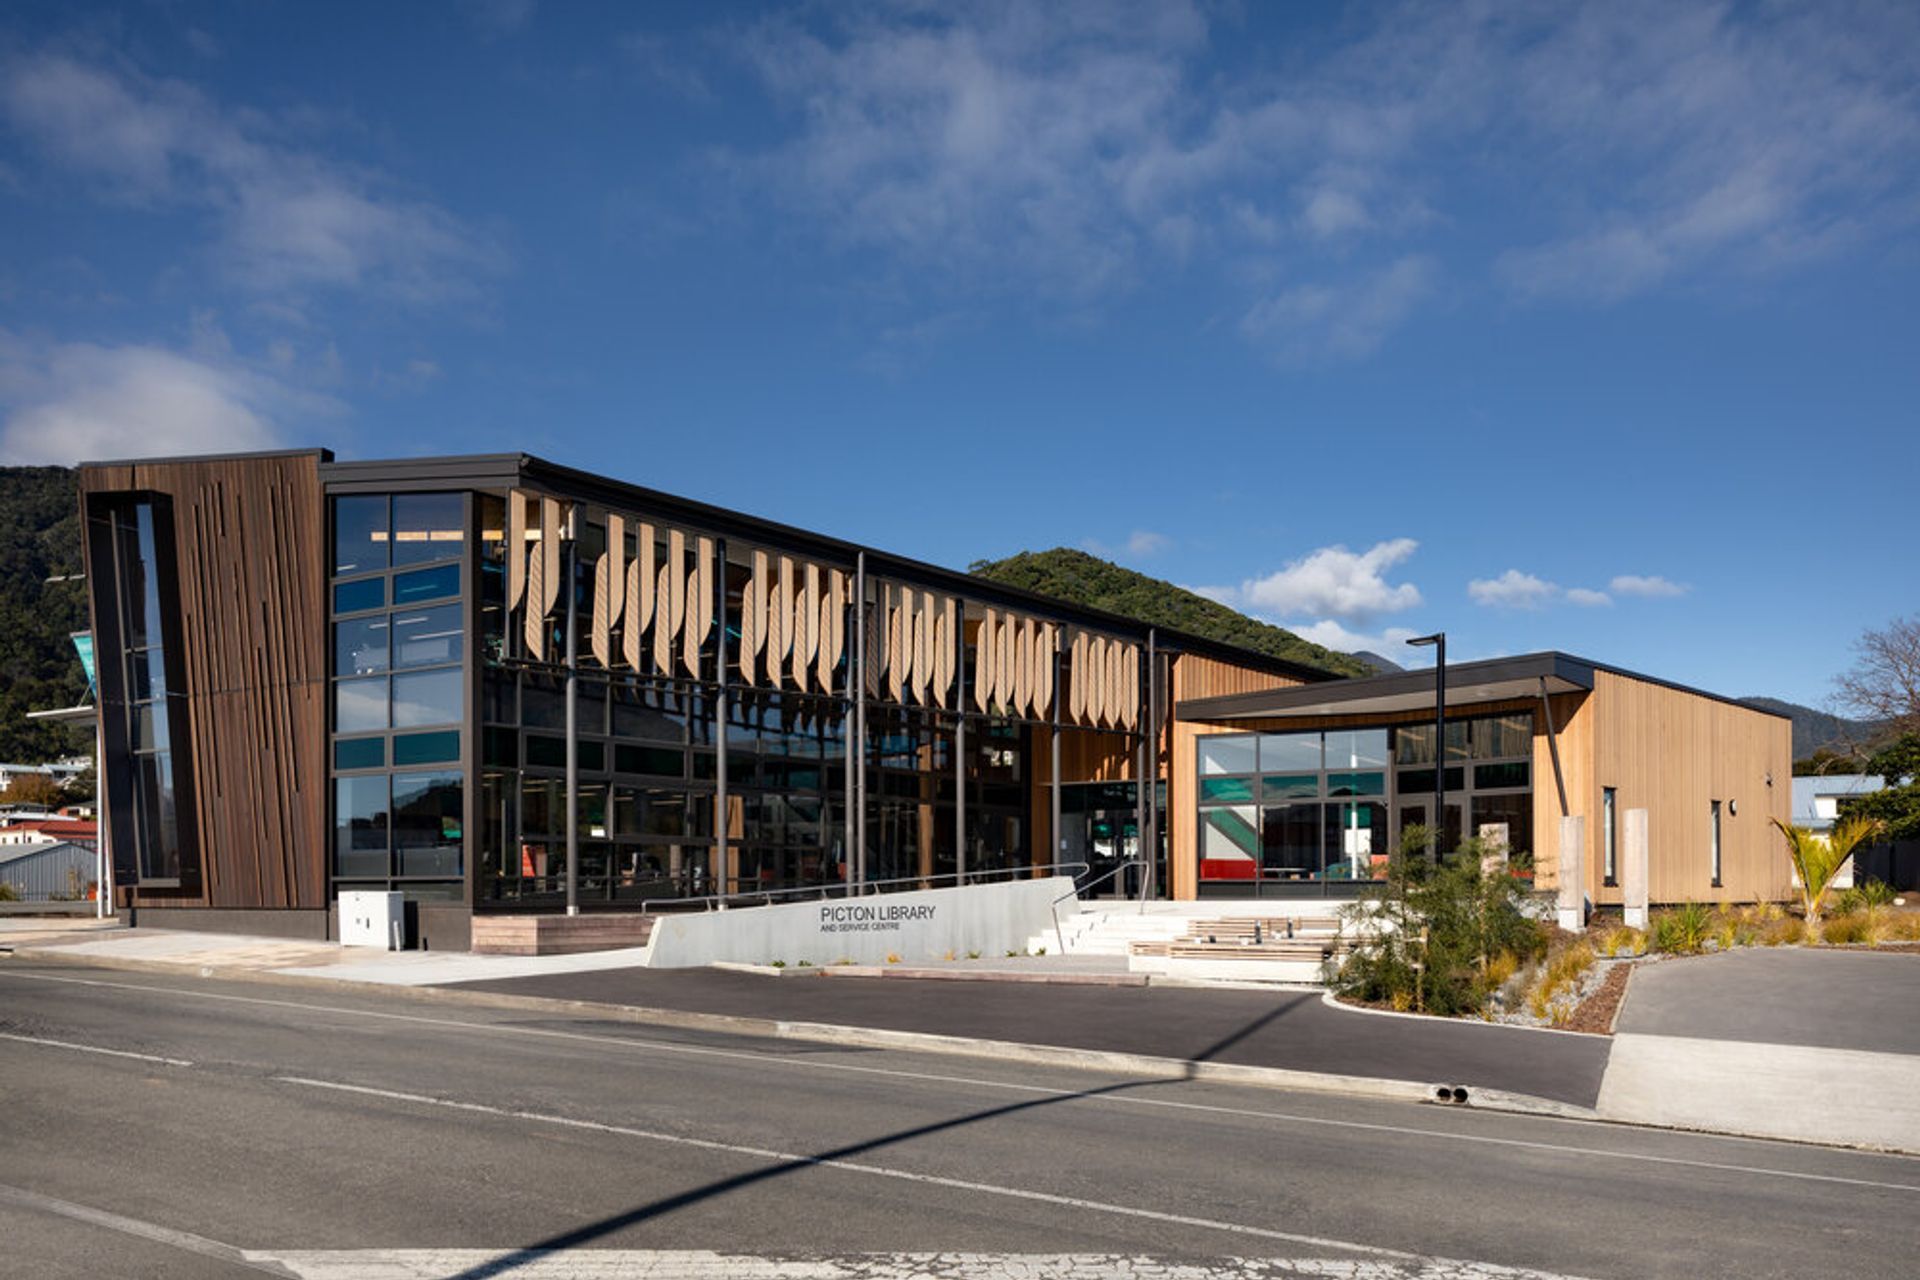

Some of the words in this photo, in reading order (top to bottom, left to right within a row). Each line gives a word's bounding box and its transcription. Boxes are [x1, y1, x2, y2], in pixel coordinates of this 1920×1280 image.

[821, 906, 875, 921] PICTON
[879, 905, 936, 920] LIBRARY
[820, 923, 837, 932] AND
[839, 923, 869, 932] SERVICE
[871, 922, 900, 931] CENTRE
